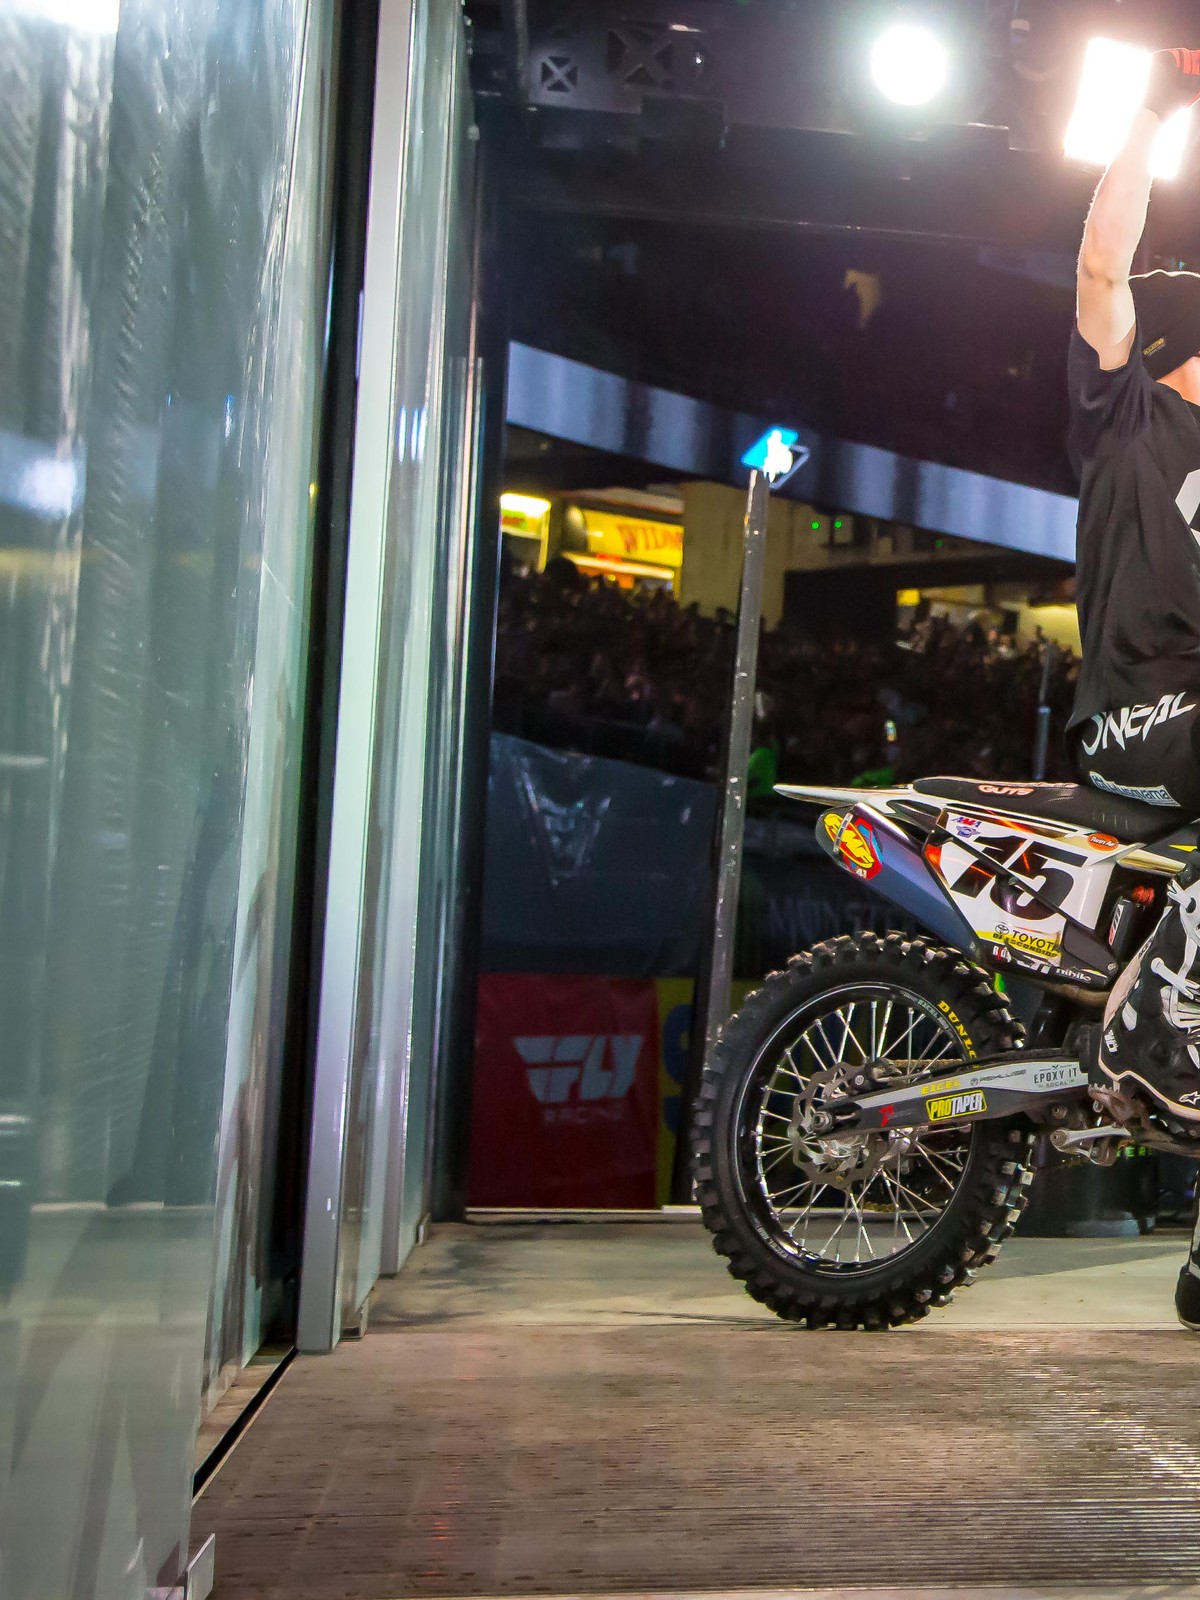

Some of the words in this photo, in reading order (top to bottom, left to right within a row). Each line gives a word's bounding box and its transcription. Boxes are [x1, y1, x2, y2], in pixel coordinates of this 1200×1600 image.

[978, 784, 1035, 796] GUTS
[949, 835, 1089, 922] 15
[937, 1000, 979, 1069] DUNLO
[512, 1034, 644, 1105] FLY
[920, 1079, 961, 1095] EXCEL
[1033, 1070, 1065, 1084] EPOXY
[1068, 1067, 1078, 1078] IT
